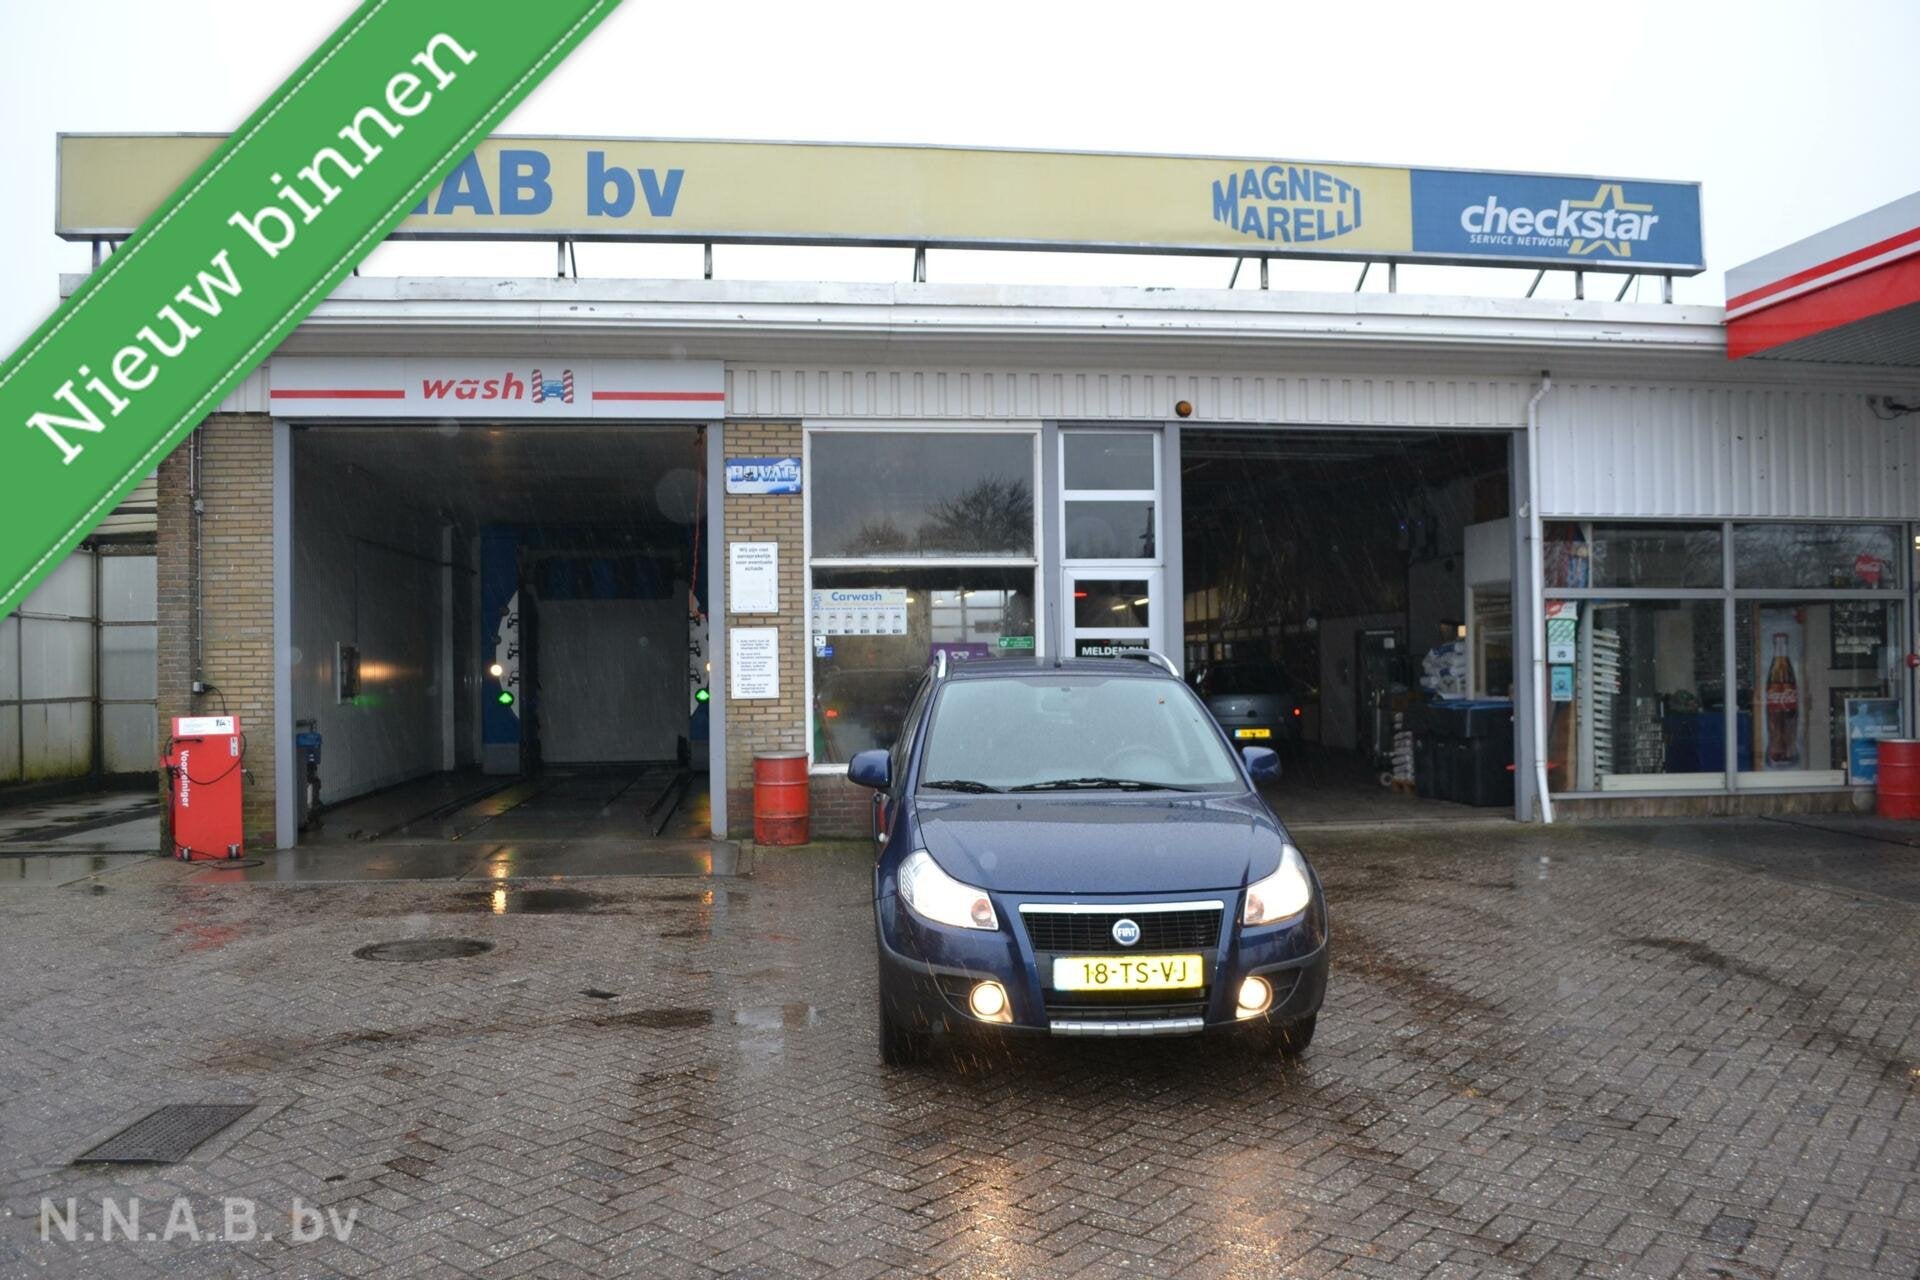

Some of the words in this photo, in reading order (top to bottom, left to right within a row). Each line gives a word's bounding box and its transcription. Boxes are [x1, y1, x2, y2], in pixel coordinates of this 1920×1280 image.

[410, 150, 553, 215] AB
[587, 151, 685, 218] bv
[1460, 195, 1660, 241] checkstar
[1470, 233, 1513, 246] SERVICE
[1517, 236, 1570, 247] NETWORK
[831, 591, 882, 601] Carwash
[1117, 927, 1136, 938] FIAT
[1083, 960, 1187, 985] 18-TS-VJ
